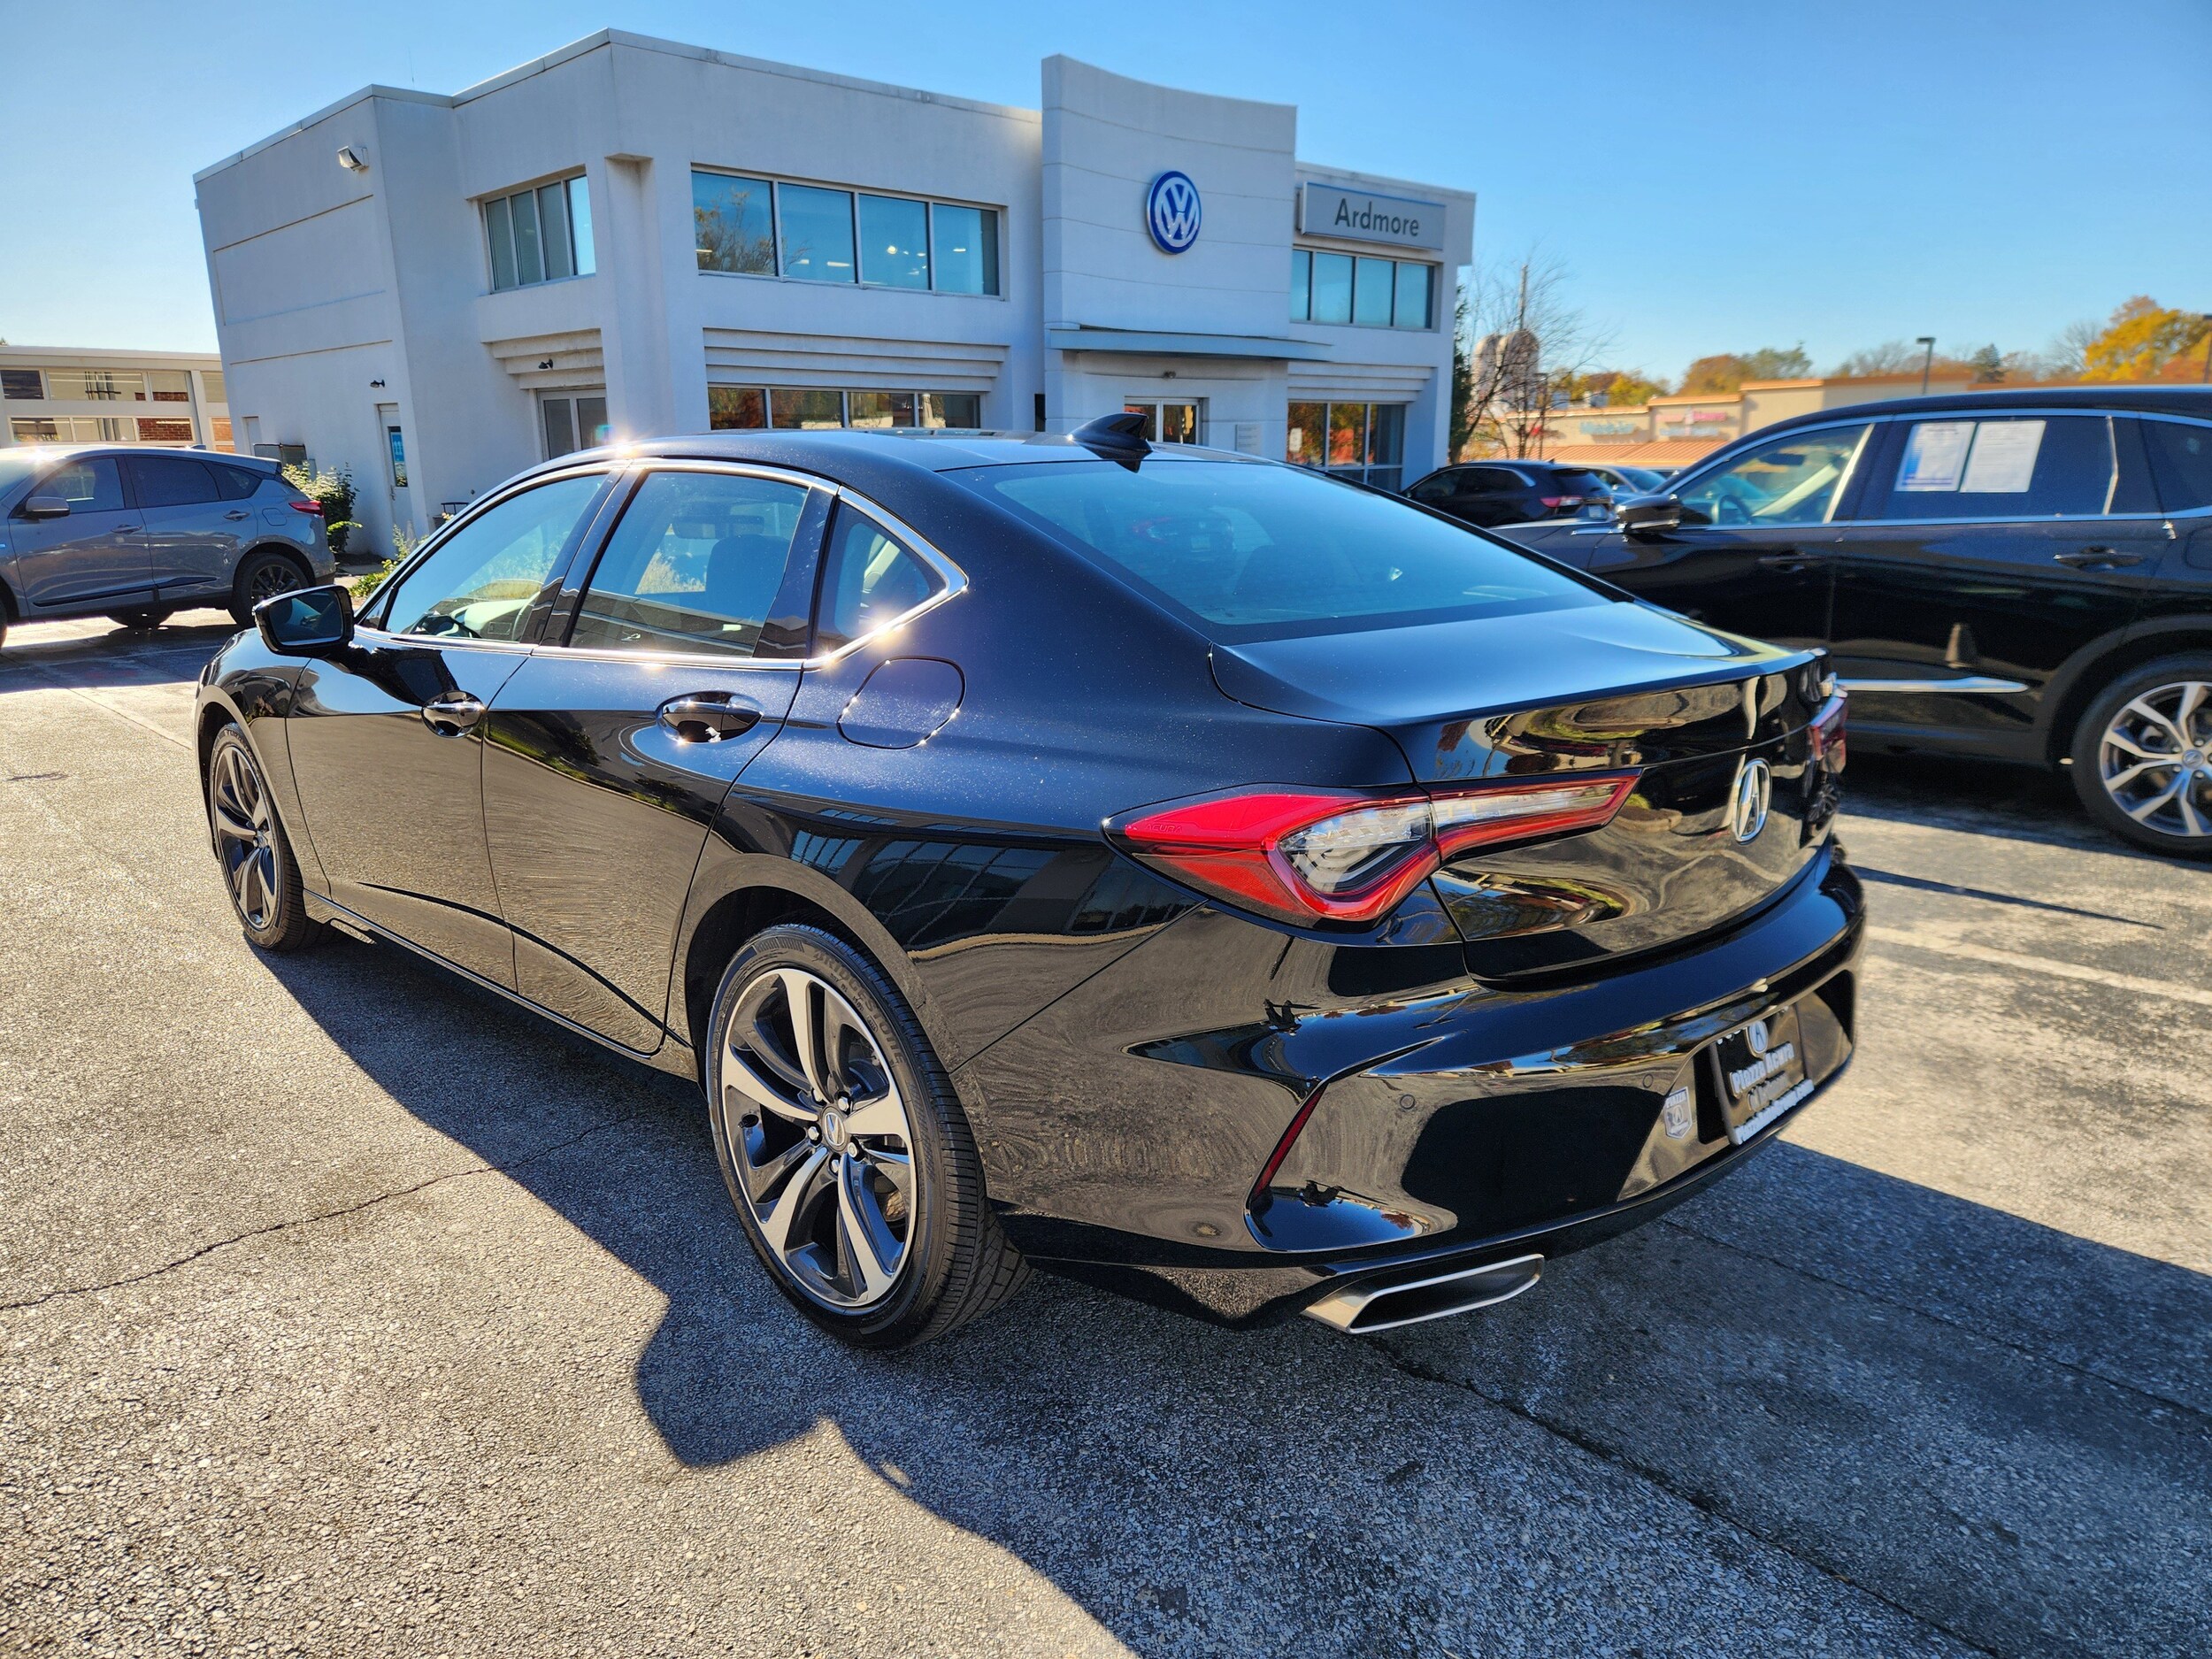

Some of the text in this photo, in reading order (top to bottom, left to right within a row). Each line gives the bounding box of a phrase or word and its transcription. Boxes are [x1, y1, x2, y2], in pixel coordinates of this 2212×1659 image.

[1152, 175, 1201, 250] VW
[1334, 197, 1420, 237] Ardmore
[1144, 823, 1183, 833] ACURA
[1732, 1061, 1767, 1094] Piazza
[1765, 1043, 1794, 1073] Acura
